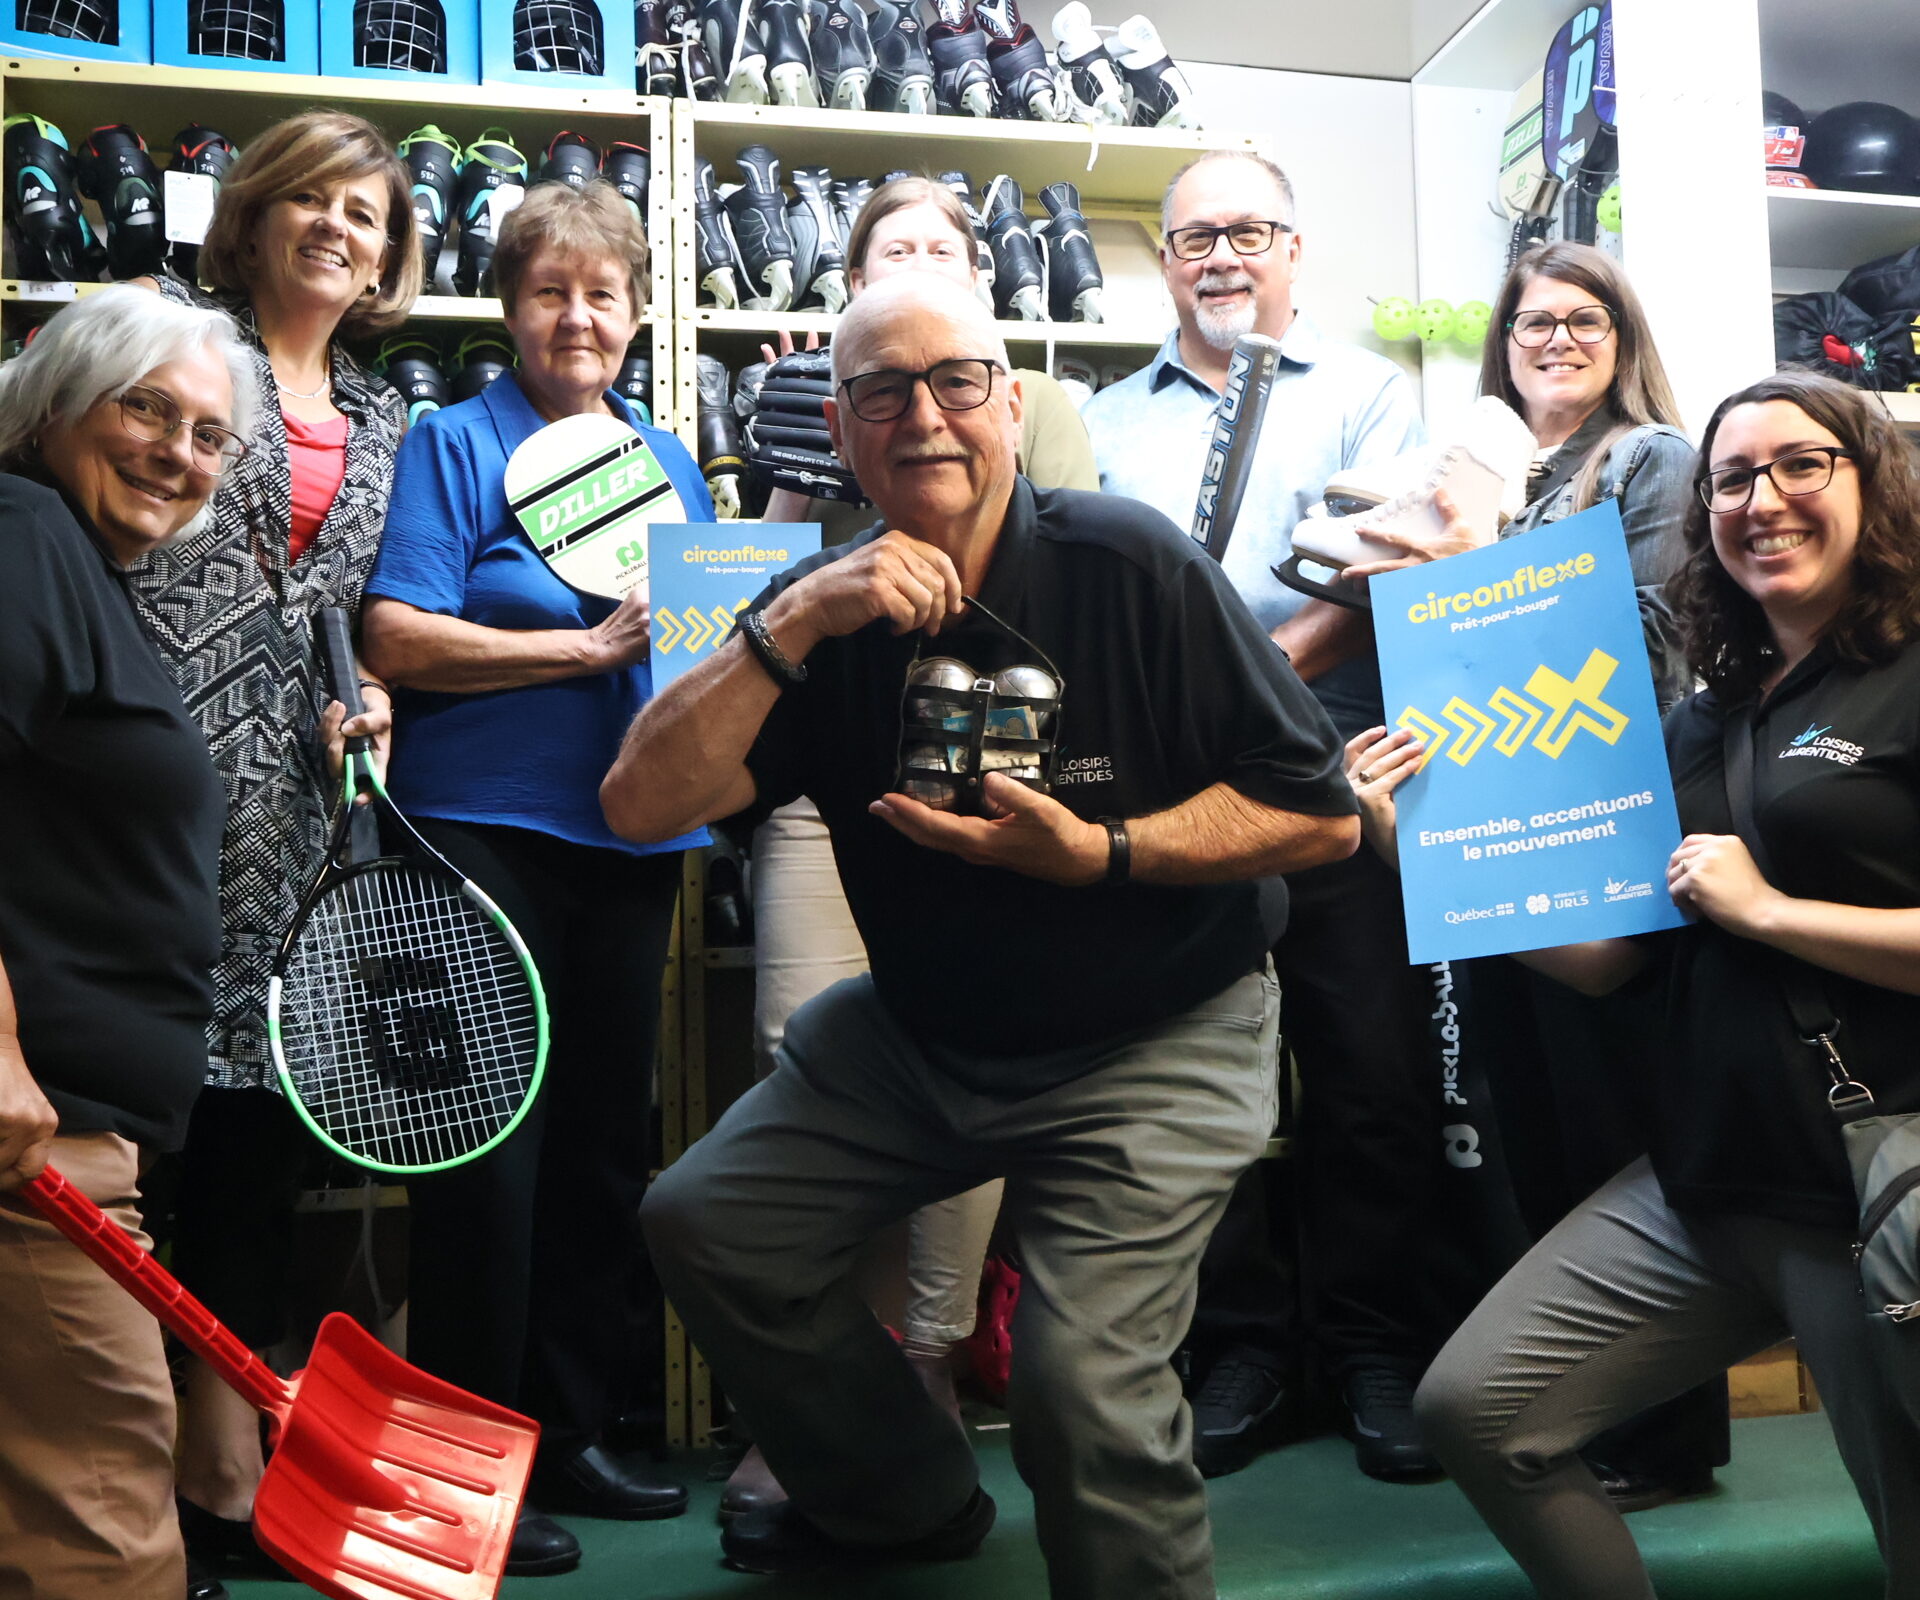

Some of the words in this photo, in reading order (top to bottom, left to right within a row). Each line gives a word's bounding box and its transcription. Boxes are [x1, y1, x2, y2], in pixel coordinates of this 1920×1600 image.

[1599, 19, 1613, 87] RIVAL
[1503, 115, 1543, 158] DILLE
[1191, 349, 1253, 549] EASTON
[539, 457, 650, 537] DILLER
[683, 544, 788, 563] circonflexe
[615, 561, 648, 580] PICKLEBALL
[705, 565, 767, 575] Prêt-pour-bouger
[1408, 552, 1597, 624] circonflexe
[1450, 594, 1561, 633] Prêt-pour-bouger
[1779, 746, 1860, 766] LAURENTIDES
[1813, 736, 1865, 757] LOISIRS
[1061, 756, 1112, 771] LOISIRS
[1057, 769, 1114, 785] ENTIDES
[1419, 817, 1527, 847] Ensemble,
[1530, 790, 1654, 828] accentuons
[1463, 845, 1482, 861] le
[1486, 820, 1617, 858] mouvement
[1604, 889, 1653, 903] LAURENTIDES
[1624, 883, 1652, 893] LOISIRS
[1555, 895, 1589, 910] URLS
[1444, 907, 1496, 925] Québec
